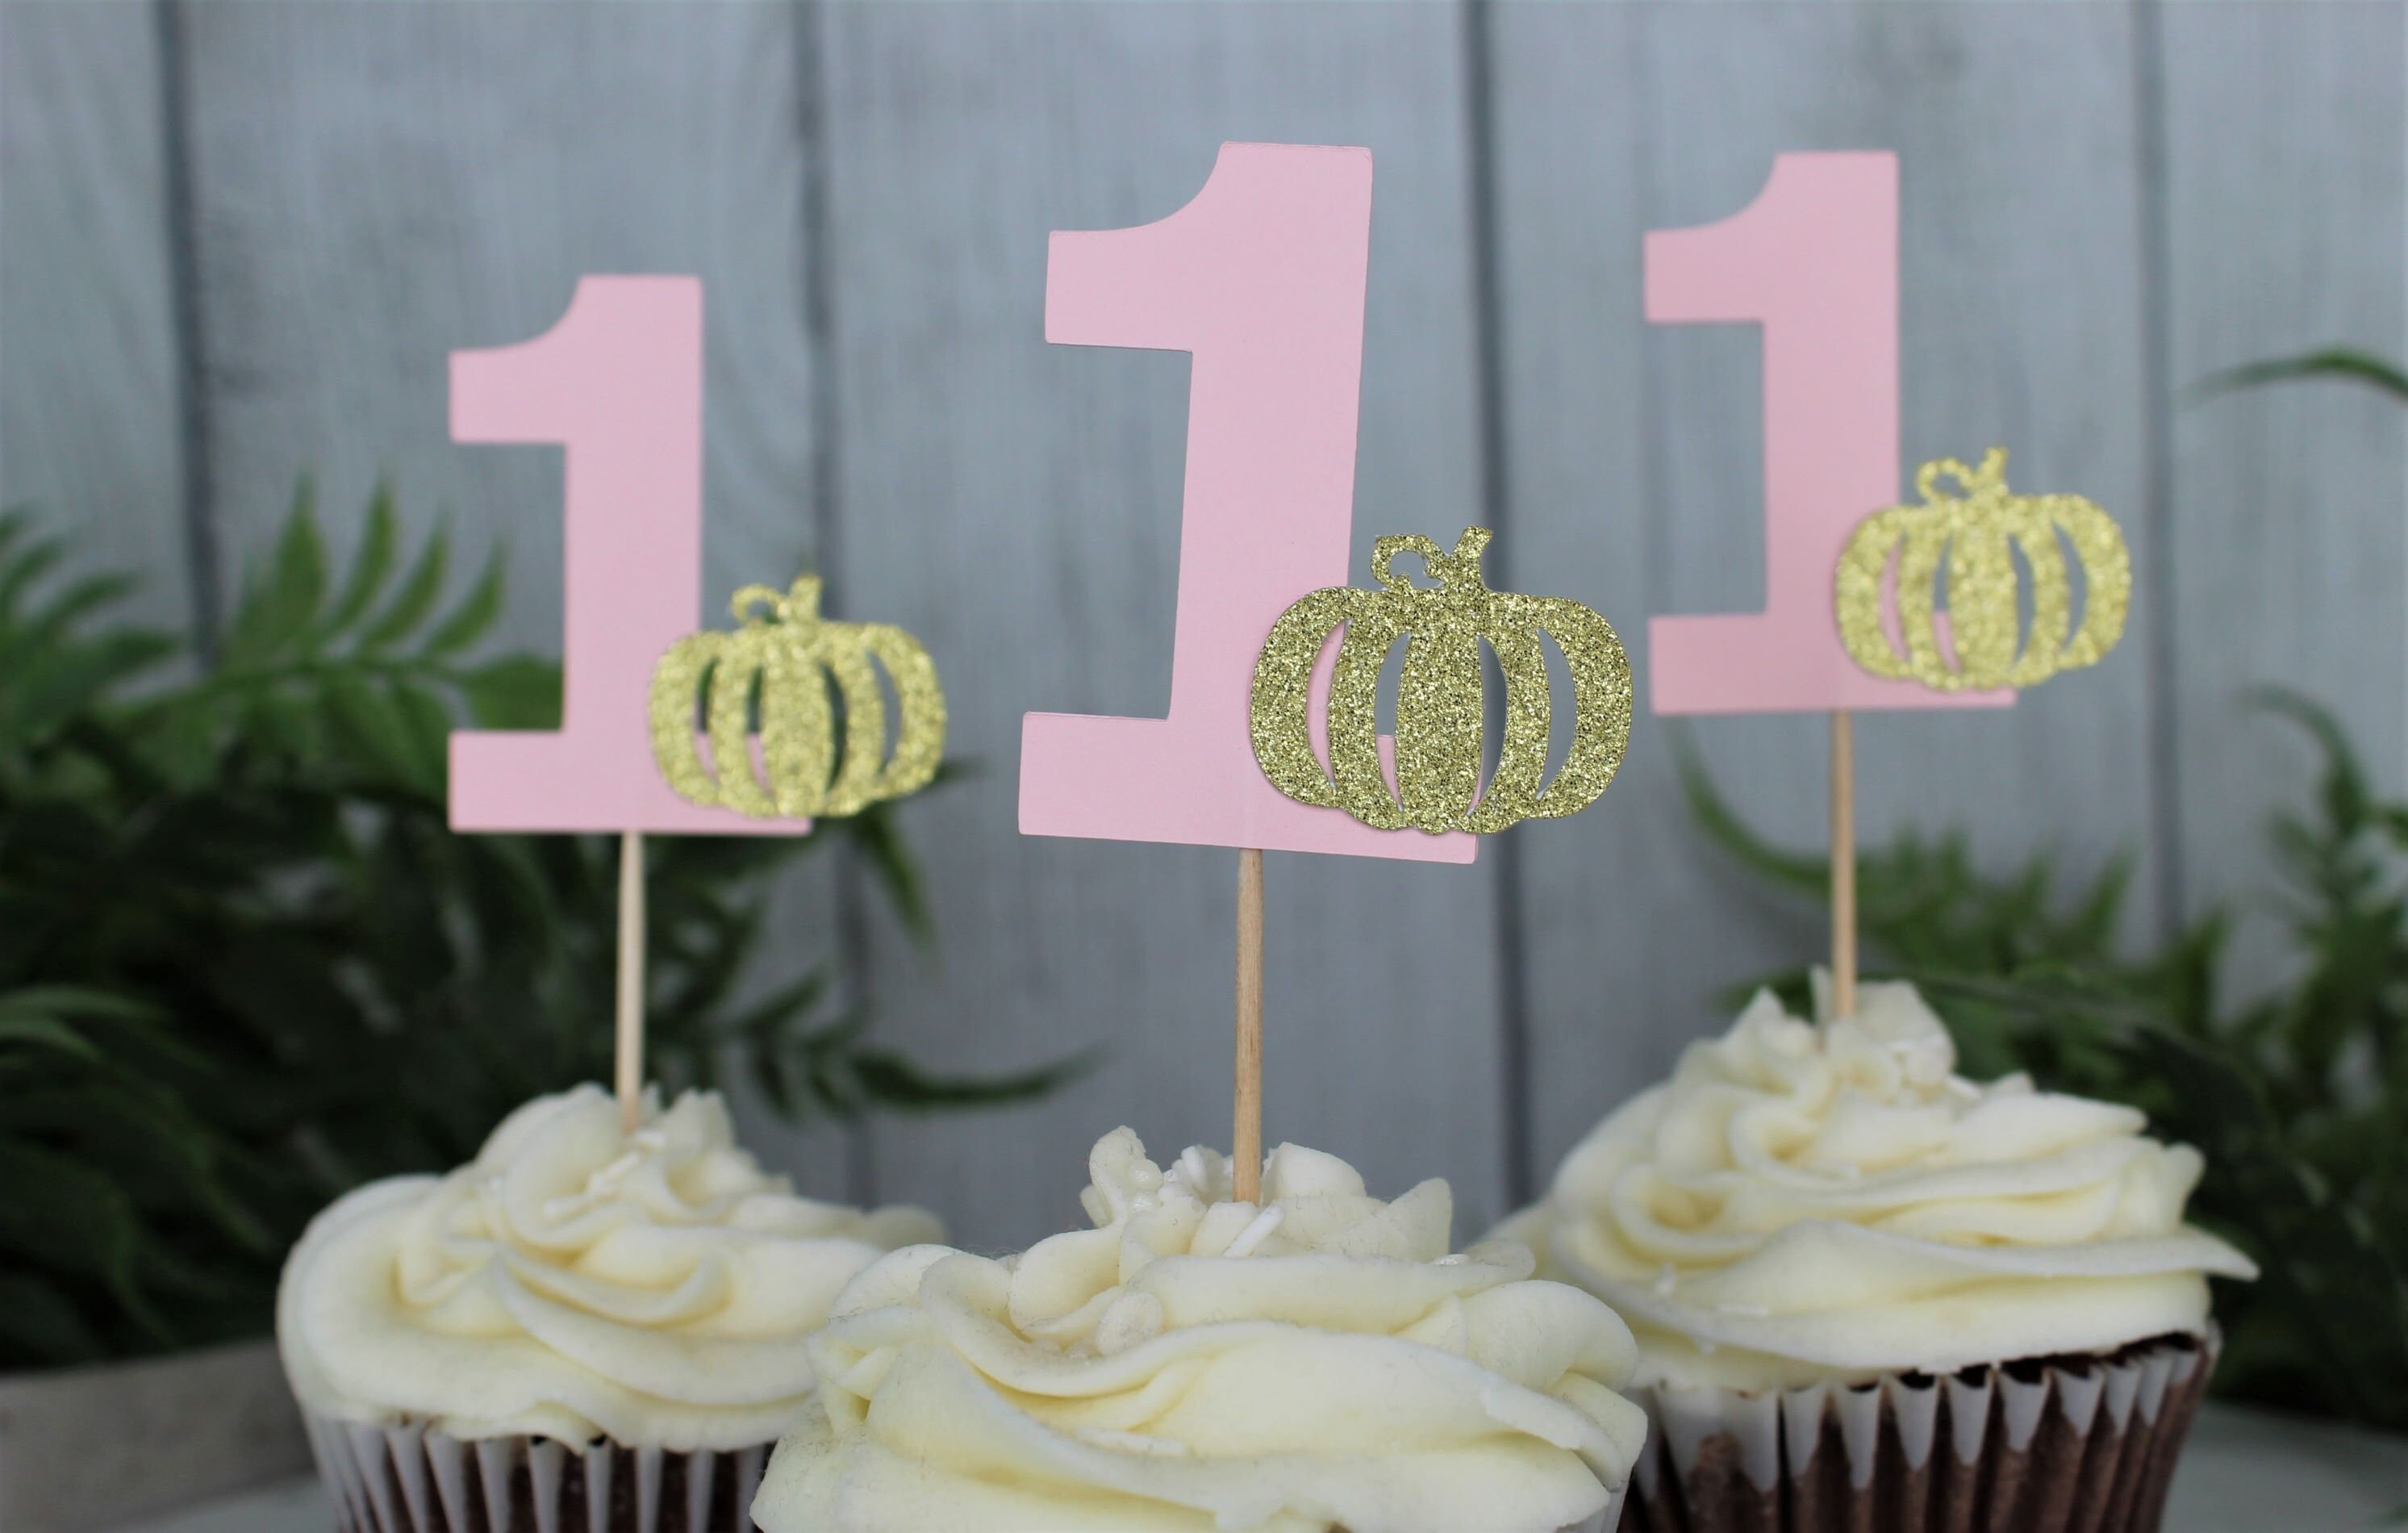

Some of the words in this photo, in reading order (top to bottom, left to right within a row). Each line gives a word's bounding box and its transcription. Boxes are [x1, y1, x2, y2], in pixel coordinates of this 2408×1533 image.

[449, 275, 810, 833] 1
[1020, 143, 1478, 864] 1
[1644, 151, 2016, 715] 1
